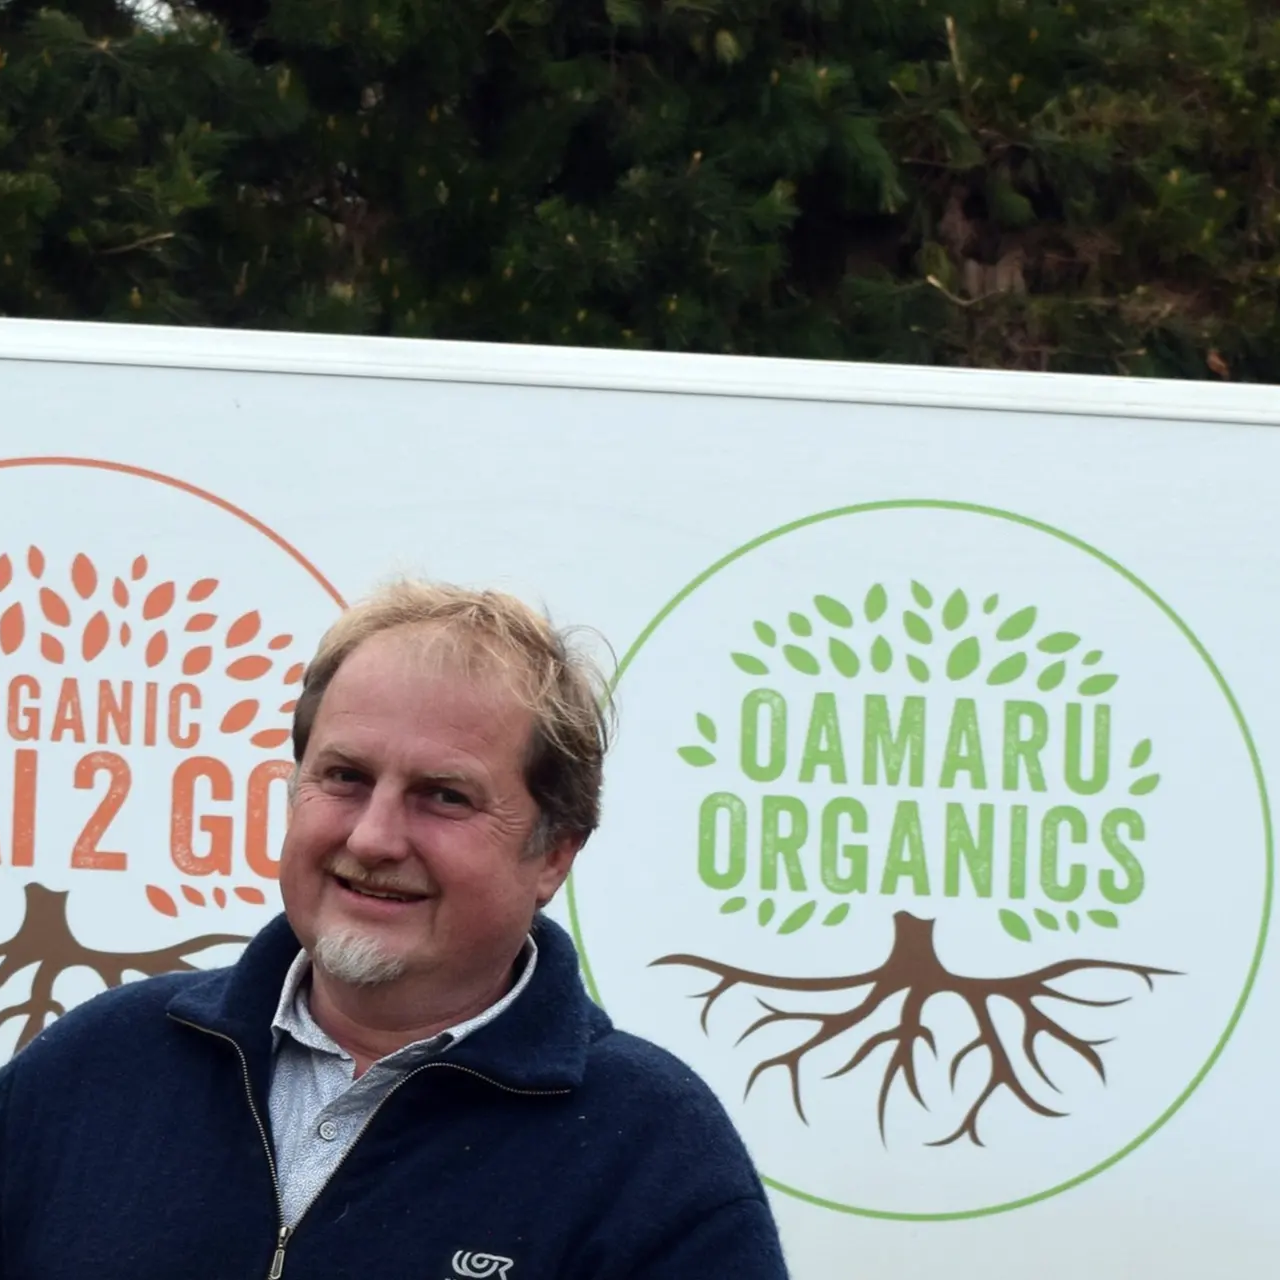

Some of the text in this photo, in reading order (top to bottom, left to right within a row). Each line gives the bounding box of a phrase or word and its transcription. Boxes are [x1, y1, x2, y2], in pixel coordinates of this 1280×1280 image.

[739, 687, 1112, 796] OAMARU
[70, 750, 133, 872] 2
[697, 790, 1147, 905] ORGANICS
